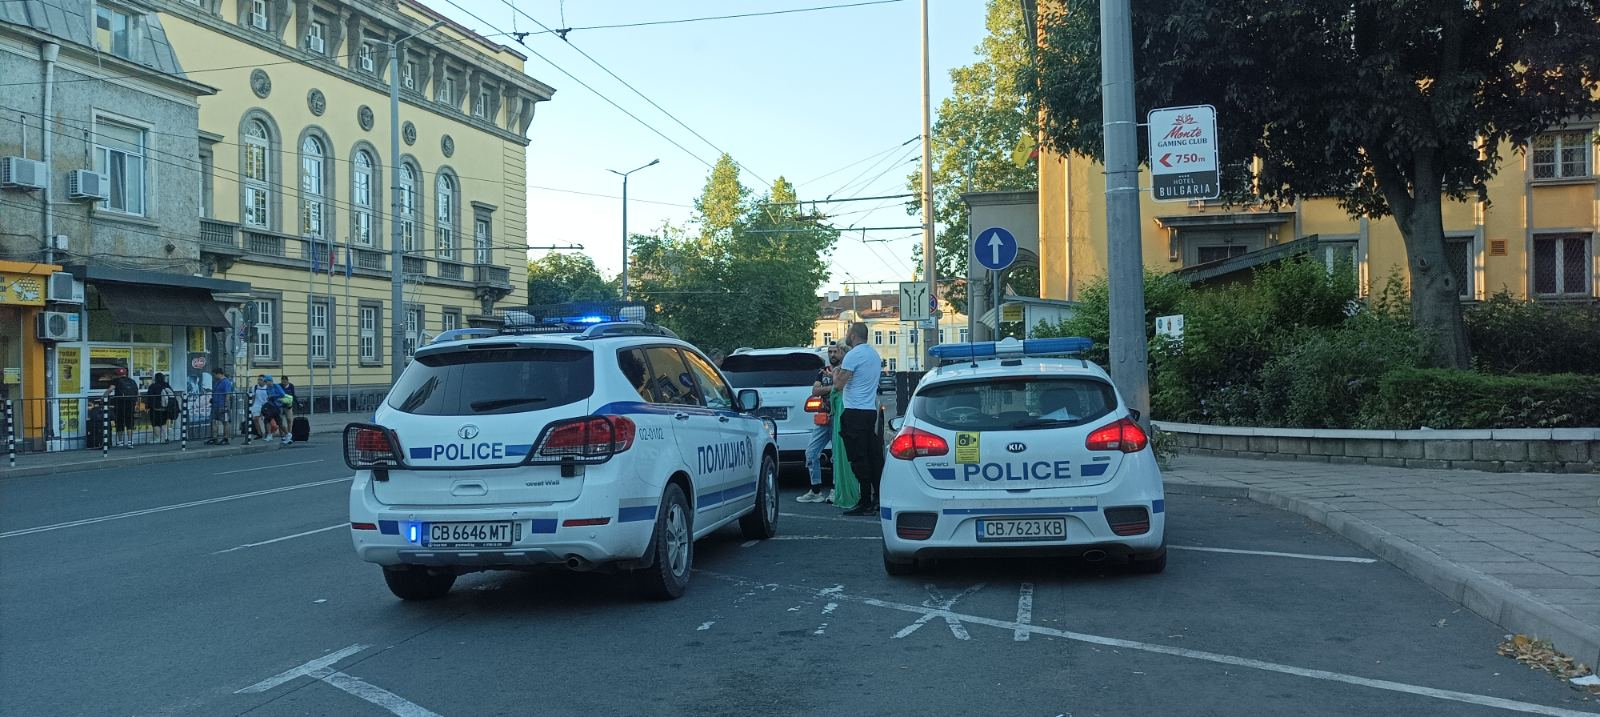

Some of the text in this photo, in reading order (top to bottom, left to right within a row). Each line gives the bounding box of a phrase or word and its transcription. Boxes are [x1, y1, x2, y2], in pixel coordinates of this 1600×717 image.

[1163, 126, 1202, 140] Monte
[1158, 138, 1208, 148] GAMING CLUB
[1159, 184, 1210, 197] BULGARIA
[638, 427, 665, 441] 02-0102
[433, 442, 503, 461] POLICE
[1008, 443, 1024, 452] KIA
[697, 440, 746, 475] ПОЛИЦИЯ
[963, 461, 1072, 482] POLICE
[431, 525, 509, 541] CB 6646 MT
